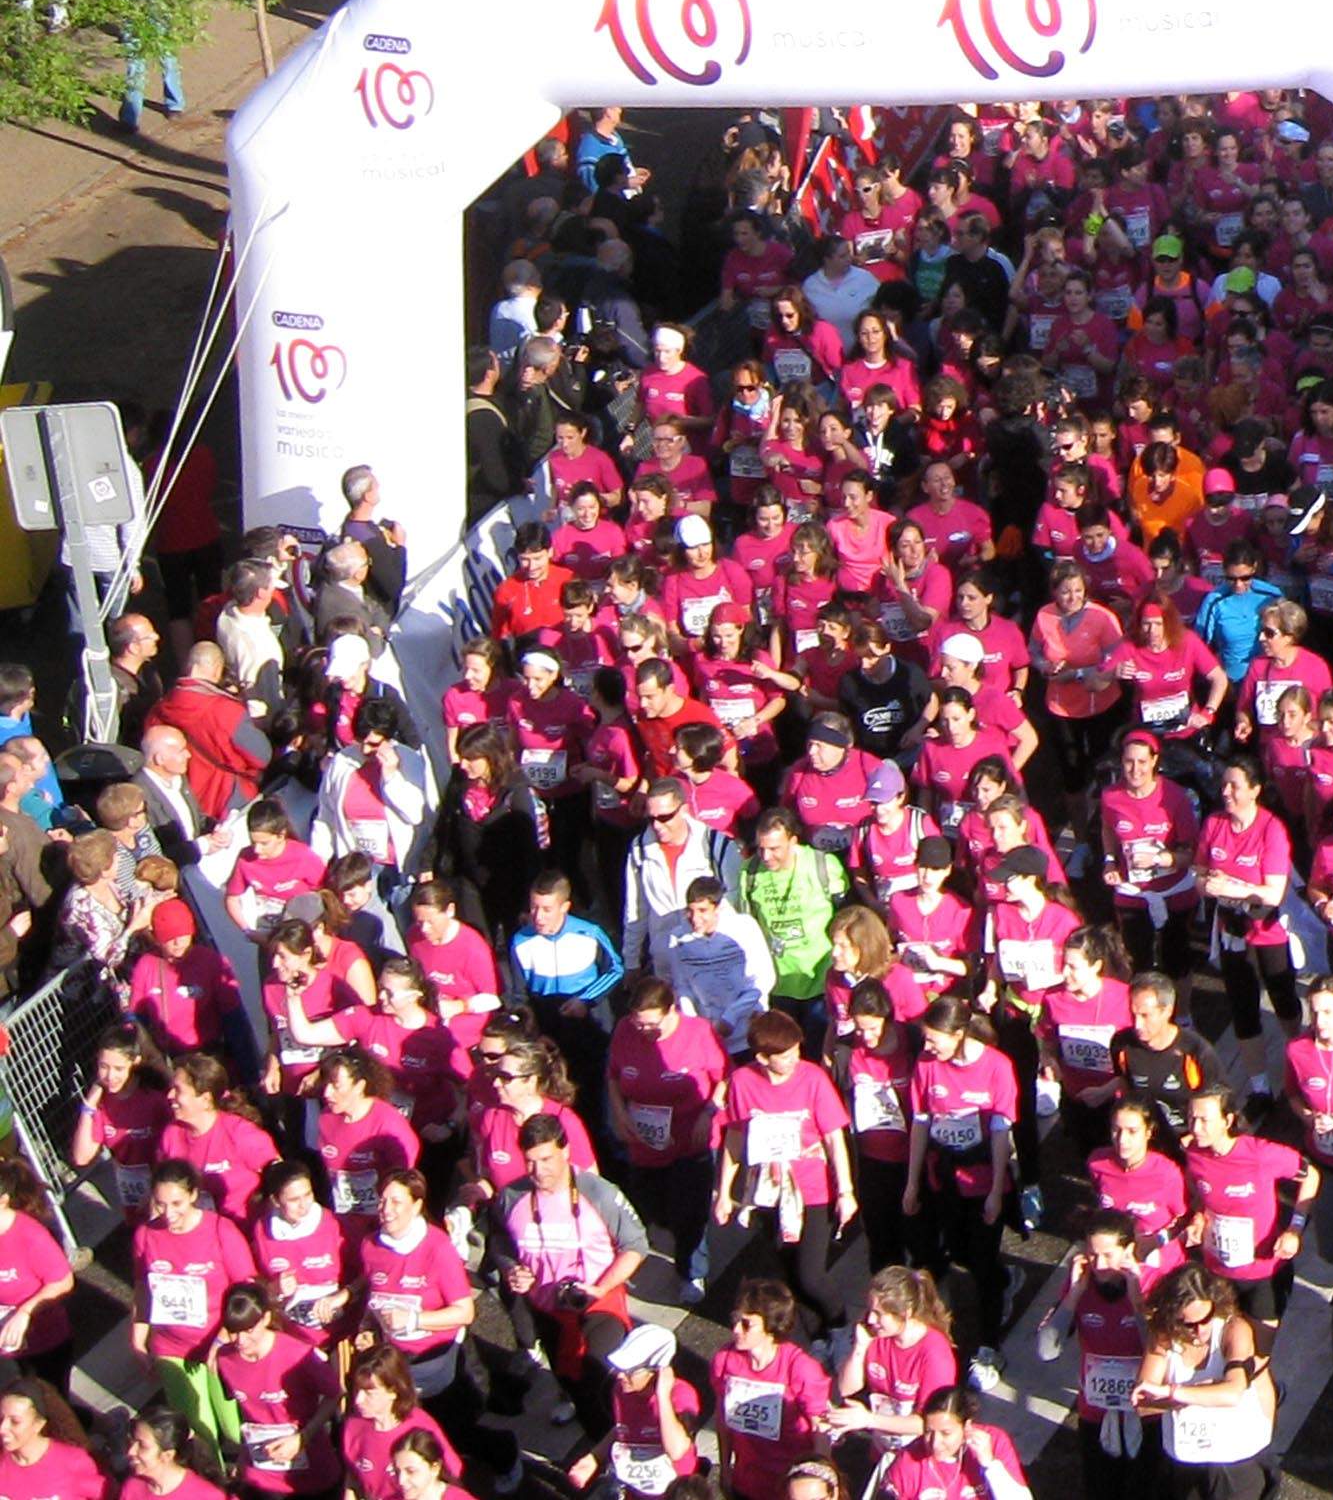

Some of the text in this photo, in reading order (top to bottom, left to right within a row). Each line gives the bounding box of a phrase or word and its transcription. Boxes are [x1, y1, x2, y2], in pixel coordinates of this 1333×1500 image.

[364, 36, 410, 53] CADENA
[274, 312, 323, 329] CADENA
[528, 767, 557, 779] 9199
[733, 1404, 768, 1420] 2255
